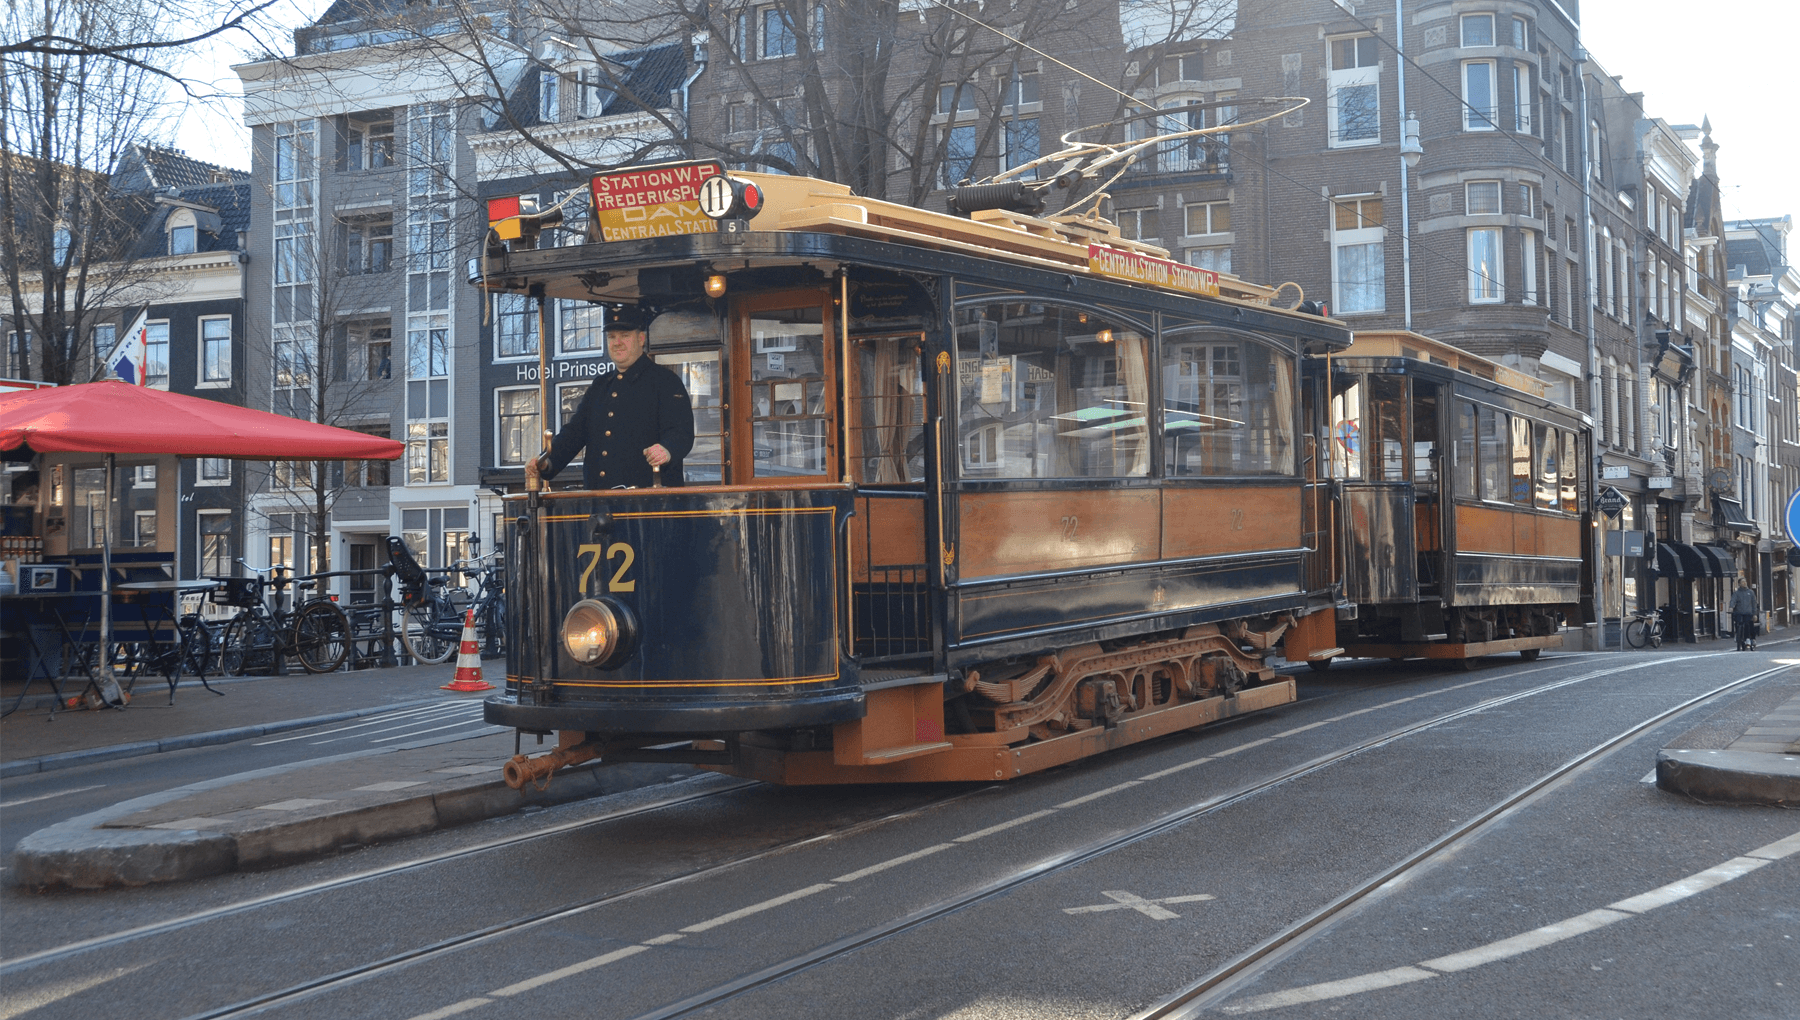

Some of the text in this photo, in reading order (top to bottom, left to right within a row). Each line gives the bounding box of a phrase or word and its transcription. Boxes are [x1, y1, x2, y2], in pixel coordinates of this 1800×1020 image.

[599, 171, 673, 191] STATION
[705, 179, 725, 213] 11
[728, 222, 737, 232] 5
[1171, 263, 1199, 290] STATION
[560, 360, 616, 378] Prinsen
[1061, 515, 1079, 543] 72
[1231, 508, 1243, 530] 72
[576, 541, 636, 593] 72
